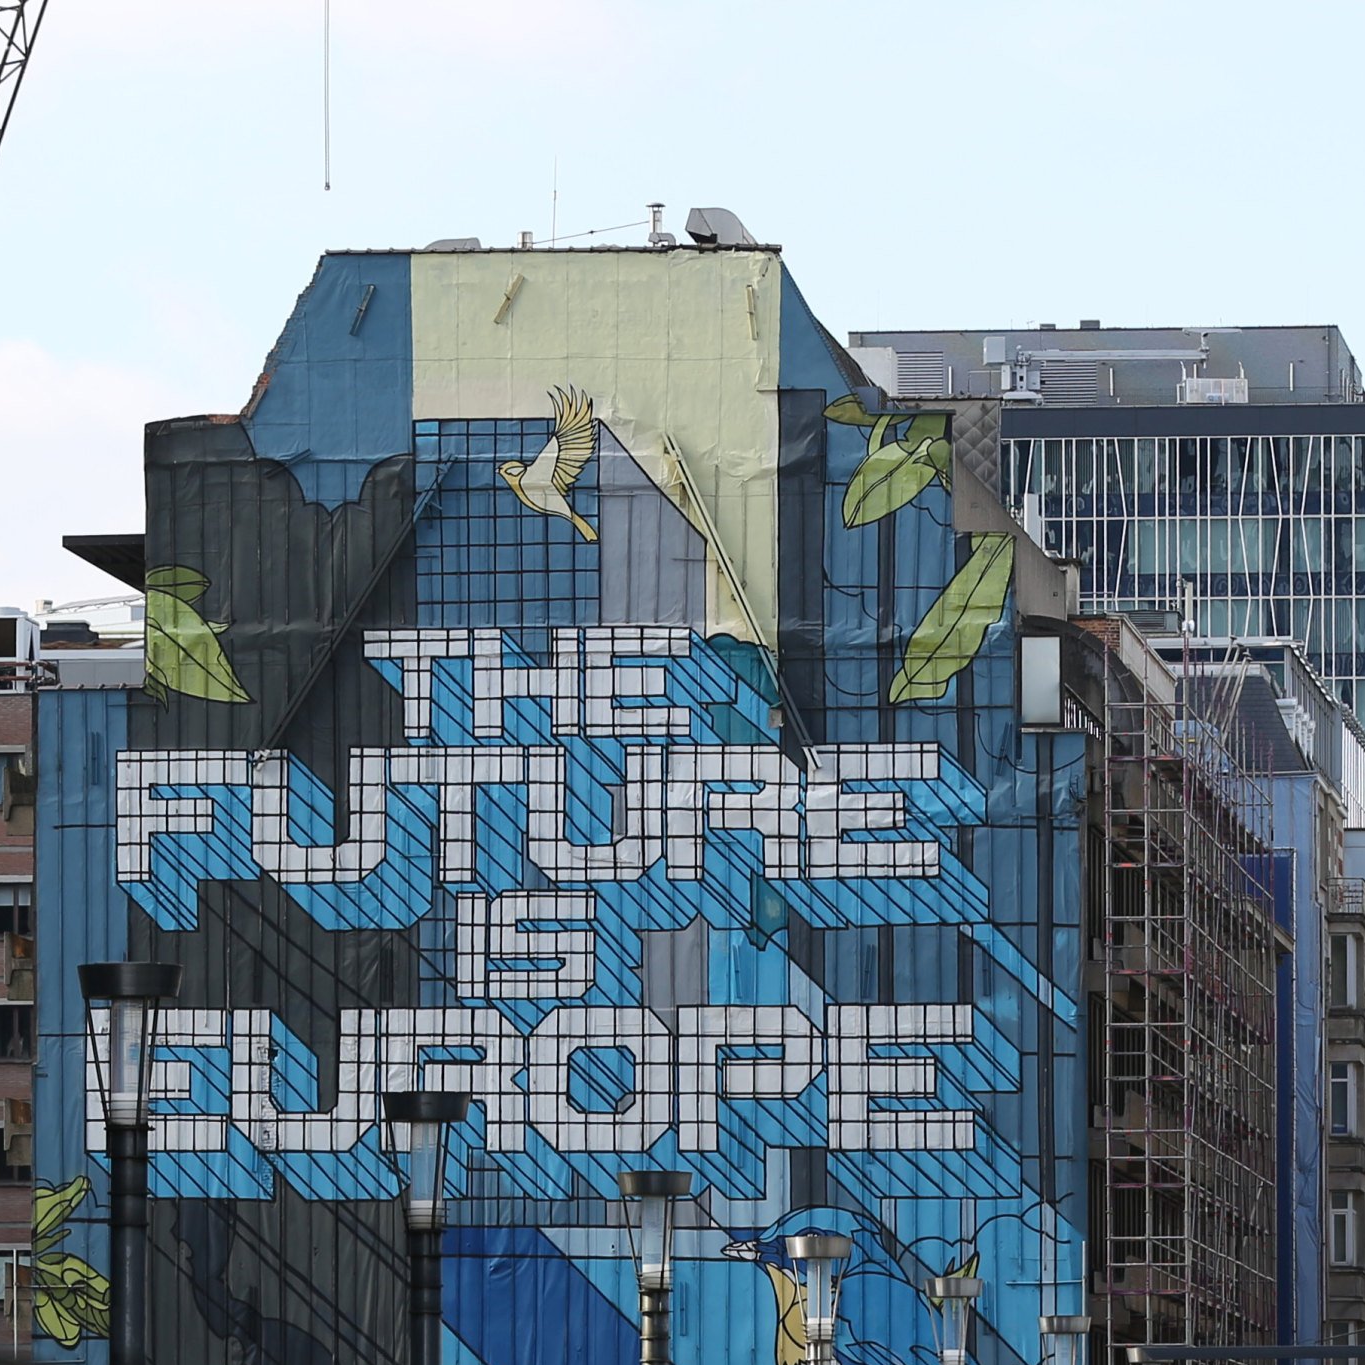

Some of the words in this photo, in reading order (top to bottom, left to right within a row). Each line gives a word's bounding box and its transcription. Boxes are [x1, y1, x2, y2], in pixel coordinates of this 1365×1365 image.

[363, 628, 692, 738] THE
[116, 741, 940, 884] FUTURE
[456, 889, 596, 1000] IS
[85, 1004, 977, 1153] EUROPE
